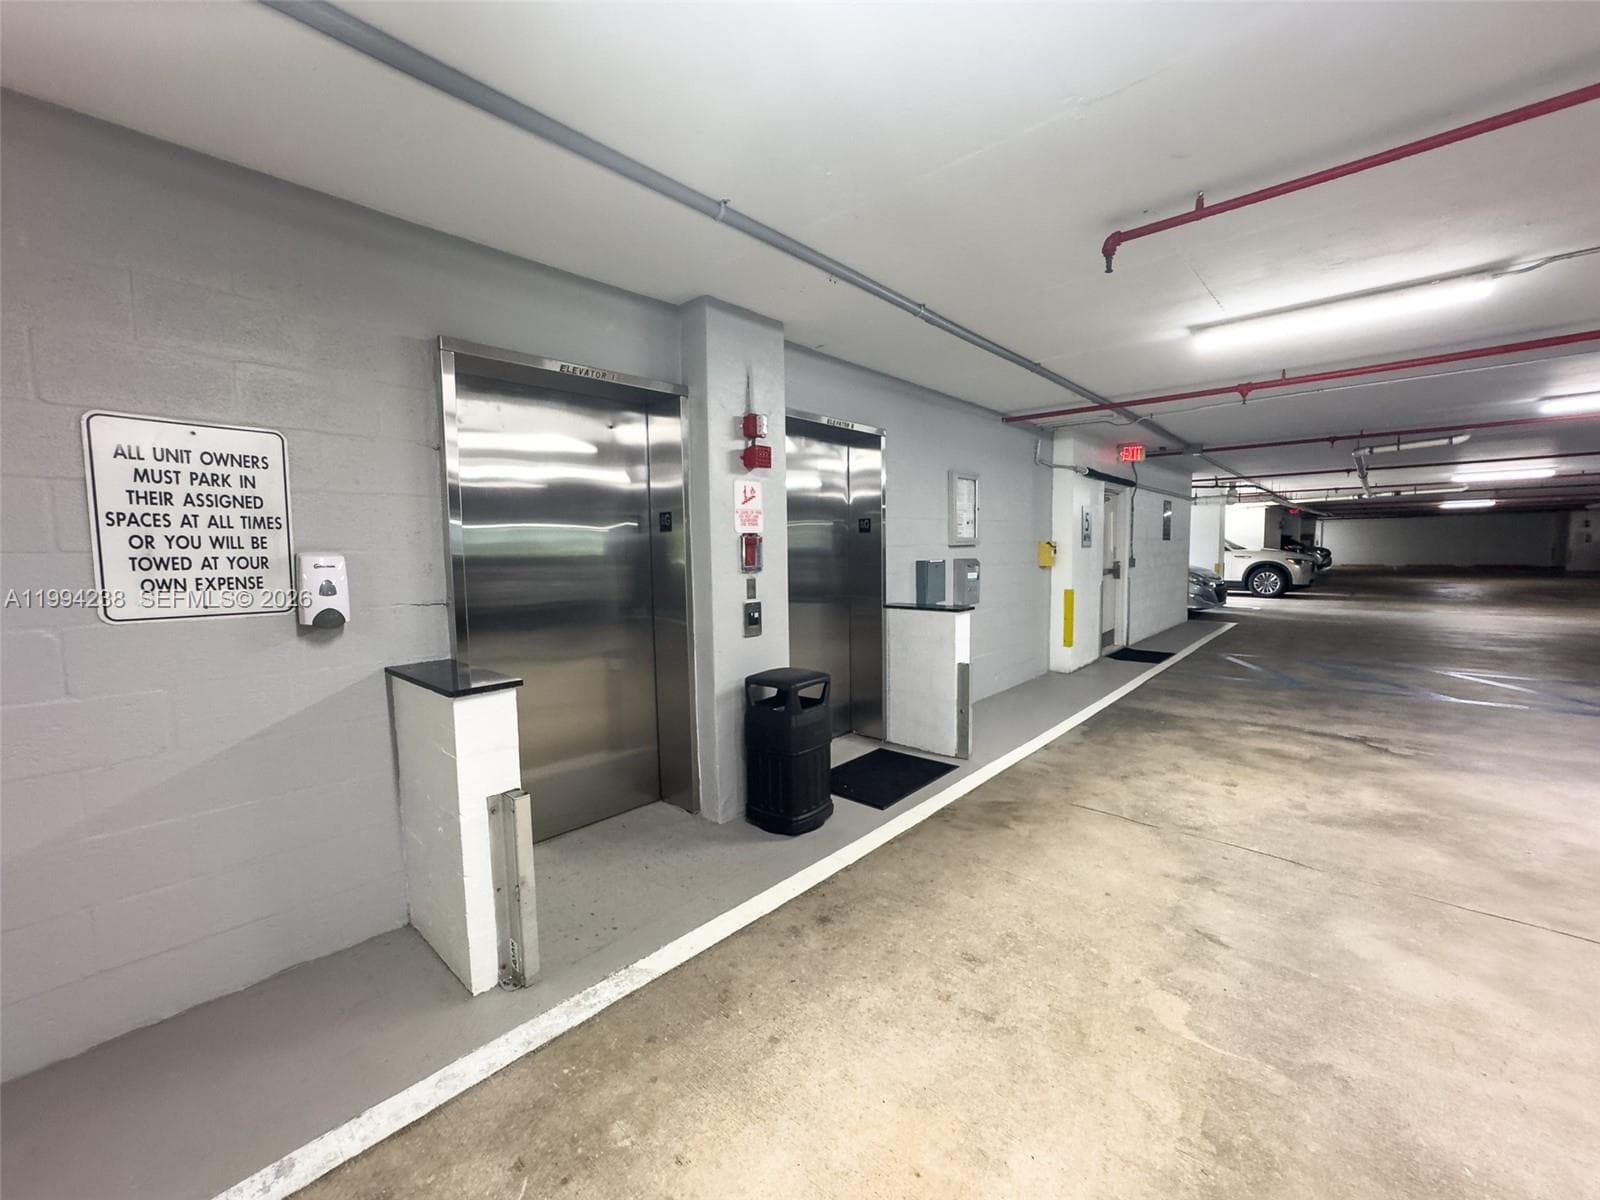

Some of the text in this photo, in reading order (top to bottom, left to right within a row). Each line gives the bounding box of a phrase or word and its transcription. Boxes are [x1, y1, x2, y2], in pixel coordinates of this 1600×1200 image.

[560, 364, 607, 379] ELEVATOR
[113, 444, 269, 470] ALL UNIT OWNERS
[1122, 446, 1143, 461] EXIT
[133, 467, 256, 489] MUST PARK IN
[125, 490, 264, 509] THEIR ASSIGNED
[105, 511, 282, 530] SPACES AT ALL TIMES
[128, 534, 268, 550] OR YOU WILL BE
[128, 556, 270, 572] TOWED AT YOUR
[140, 576, 264, 593] OWN EXPENSE
